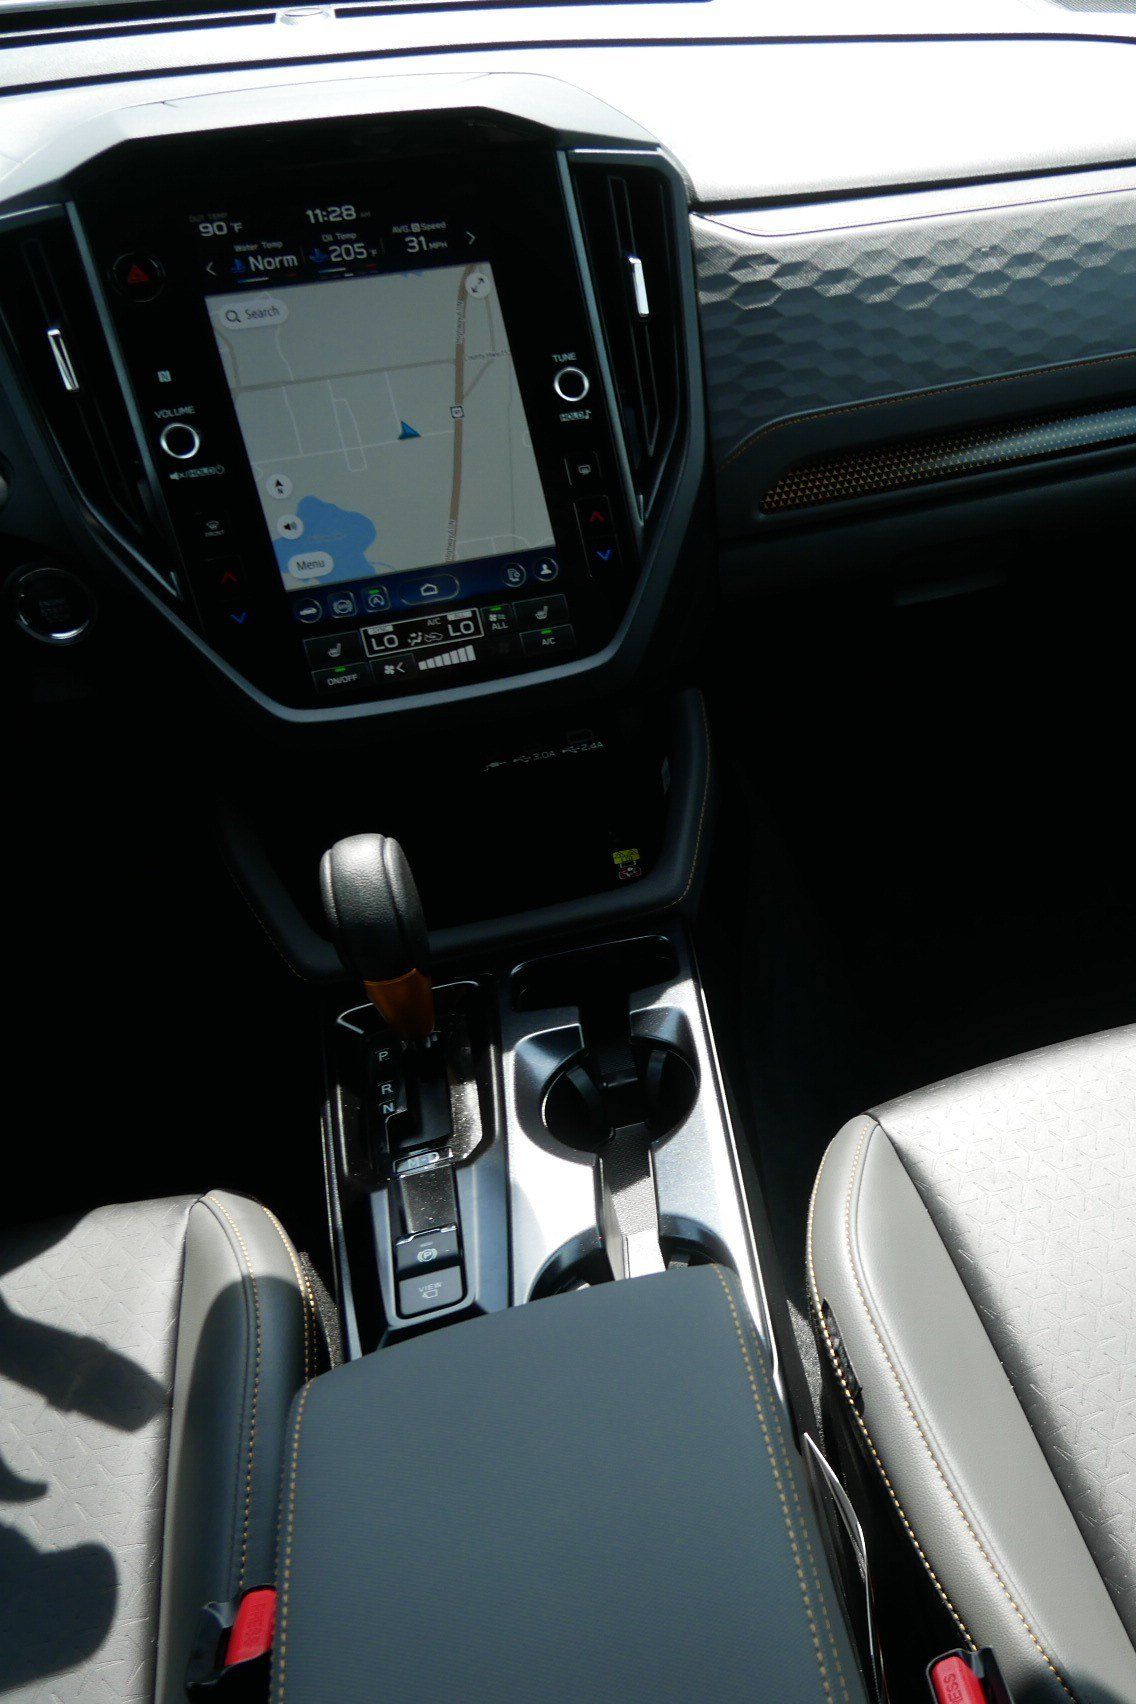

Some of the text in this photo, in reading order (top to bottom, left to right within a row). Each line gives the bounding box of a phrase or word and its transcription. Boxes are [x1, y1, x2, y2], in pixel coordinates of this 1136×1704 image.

[305, 204, 357, 224] 11:28
[198, 221, 228, 237] 90
[405, 235, 428, 253] 31
[328, 243, 368, 262] 205
[247, 254, 299, 272] Norm
[245, 305, 280, 320] Search
[155, 405, 196, 419] VOLUME
[296, 557, 326, 571] Menu
[447, 620, 475, 637] LO
[491, 621, 509, 631] ALL
[370, 634, 399, 651] LO
[541, 637, 557, 647] A/C
[326, 674, 358, 686] ON/OFF
[377, 1050, 389, 1062] P
[380, 1083, 392, 1095] R
[382, 1103, 395, 1113] N
[418, 1281, 443, 1293] VIEW
